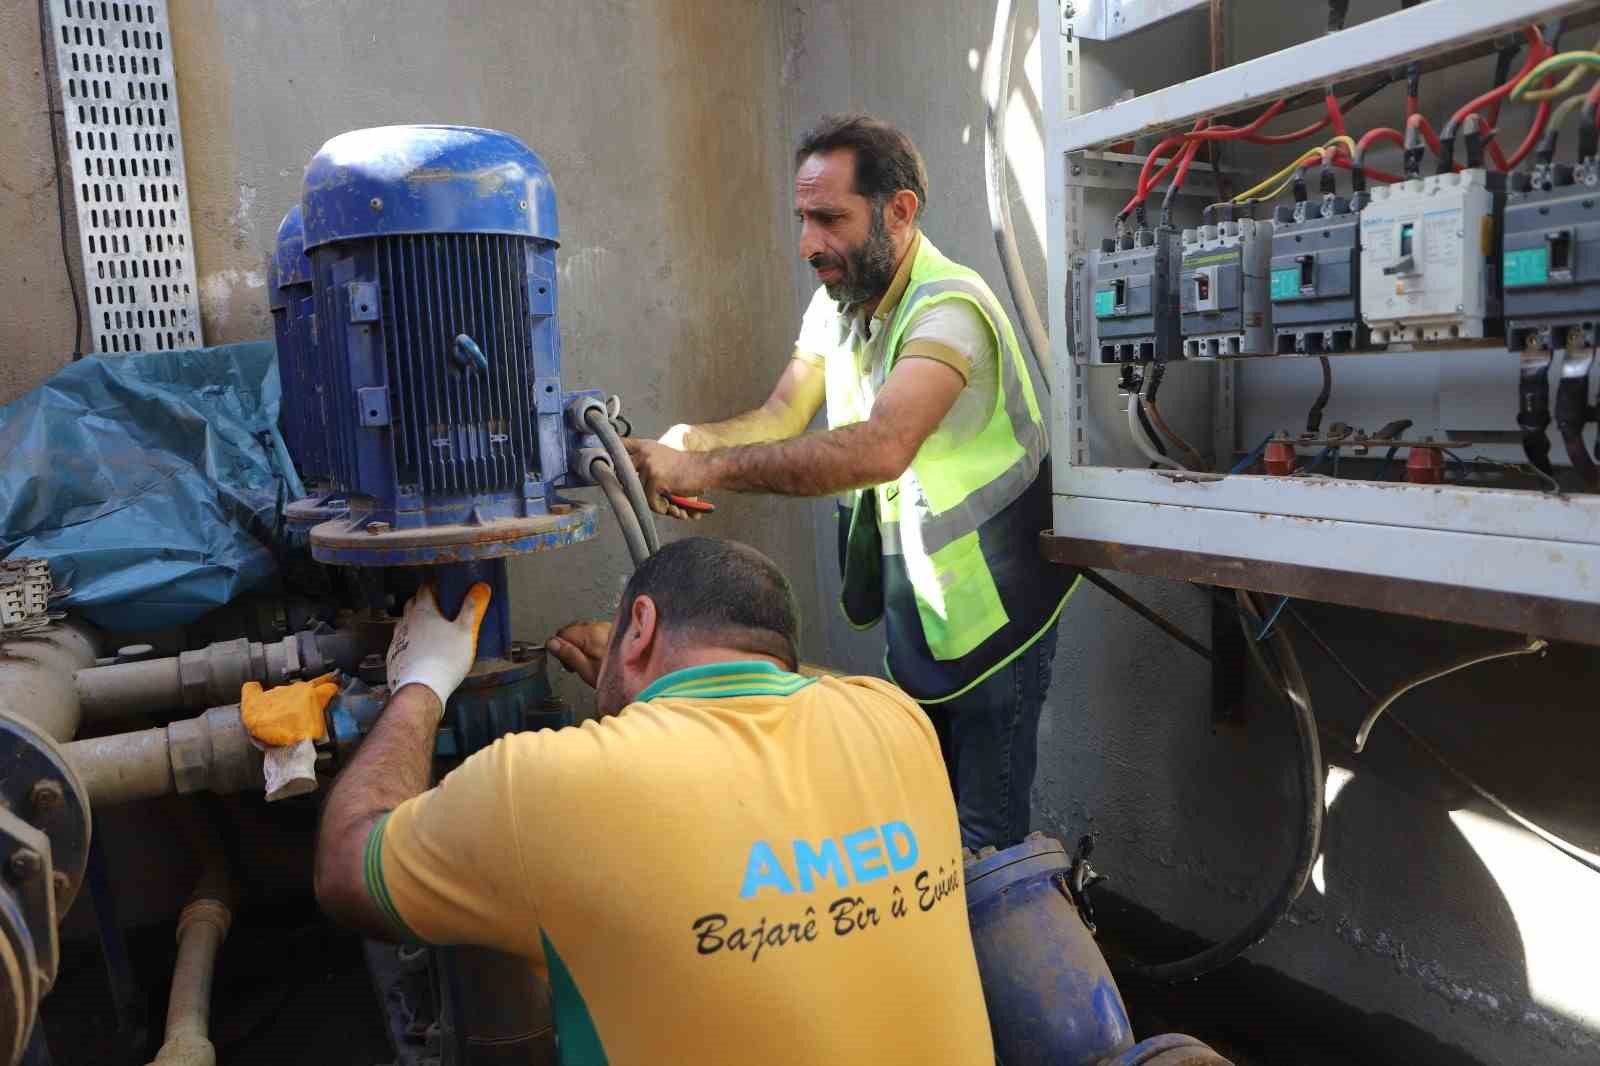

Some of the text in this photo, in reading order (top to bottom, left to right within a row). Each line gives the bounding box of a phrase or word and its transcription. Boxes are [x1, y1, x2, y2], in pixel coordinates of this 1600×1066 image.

[740, 820, 919, 899] AMED
[692, 906, 817, 962] Bajarê
[828, 896, 881, 936] Bîr
[890, 885, 908, 918] û
